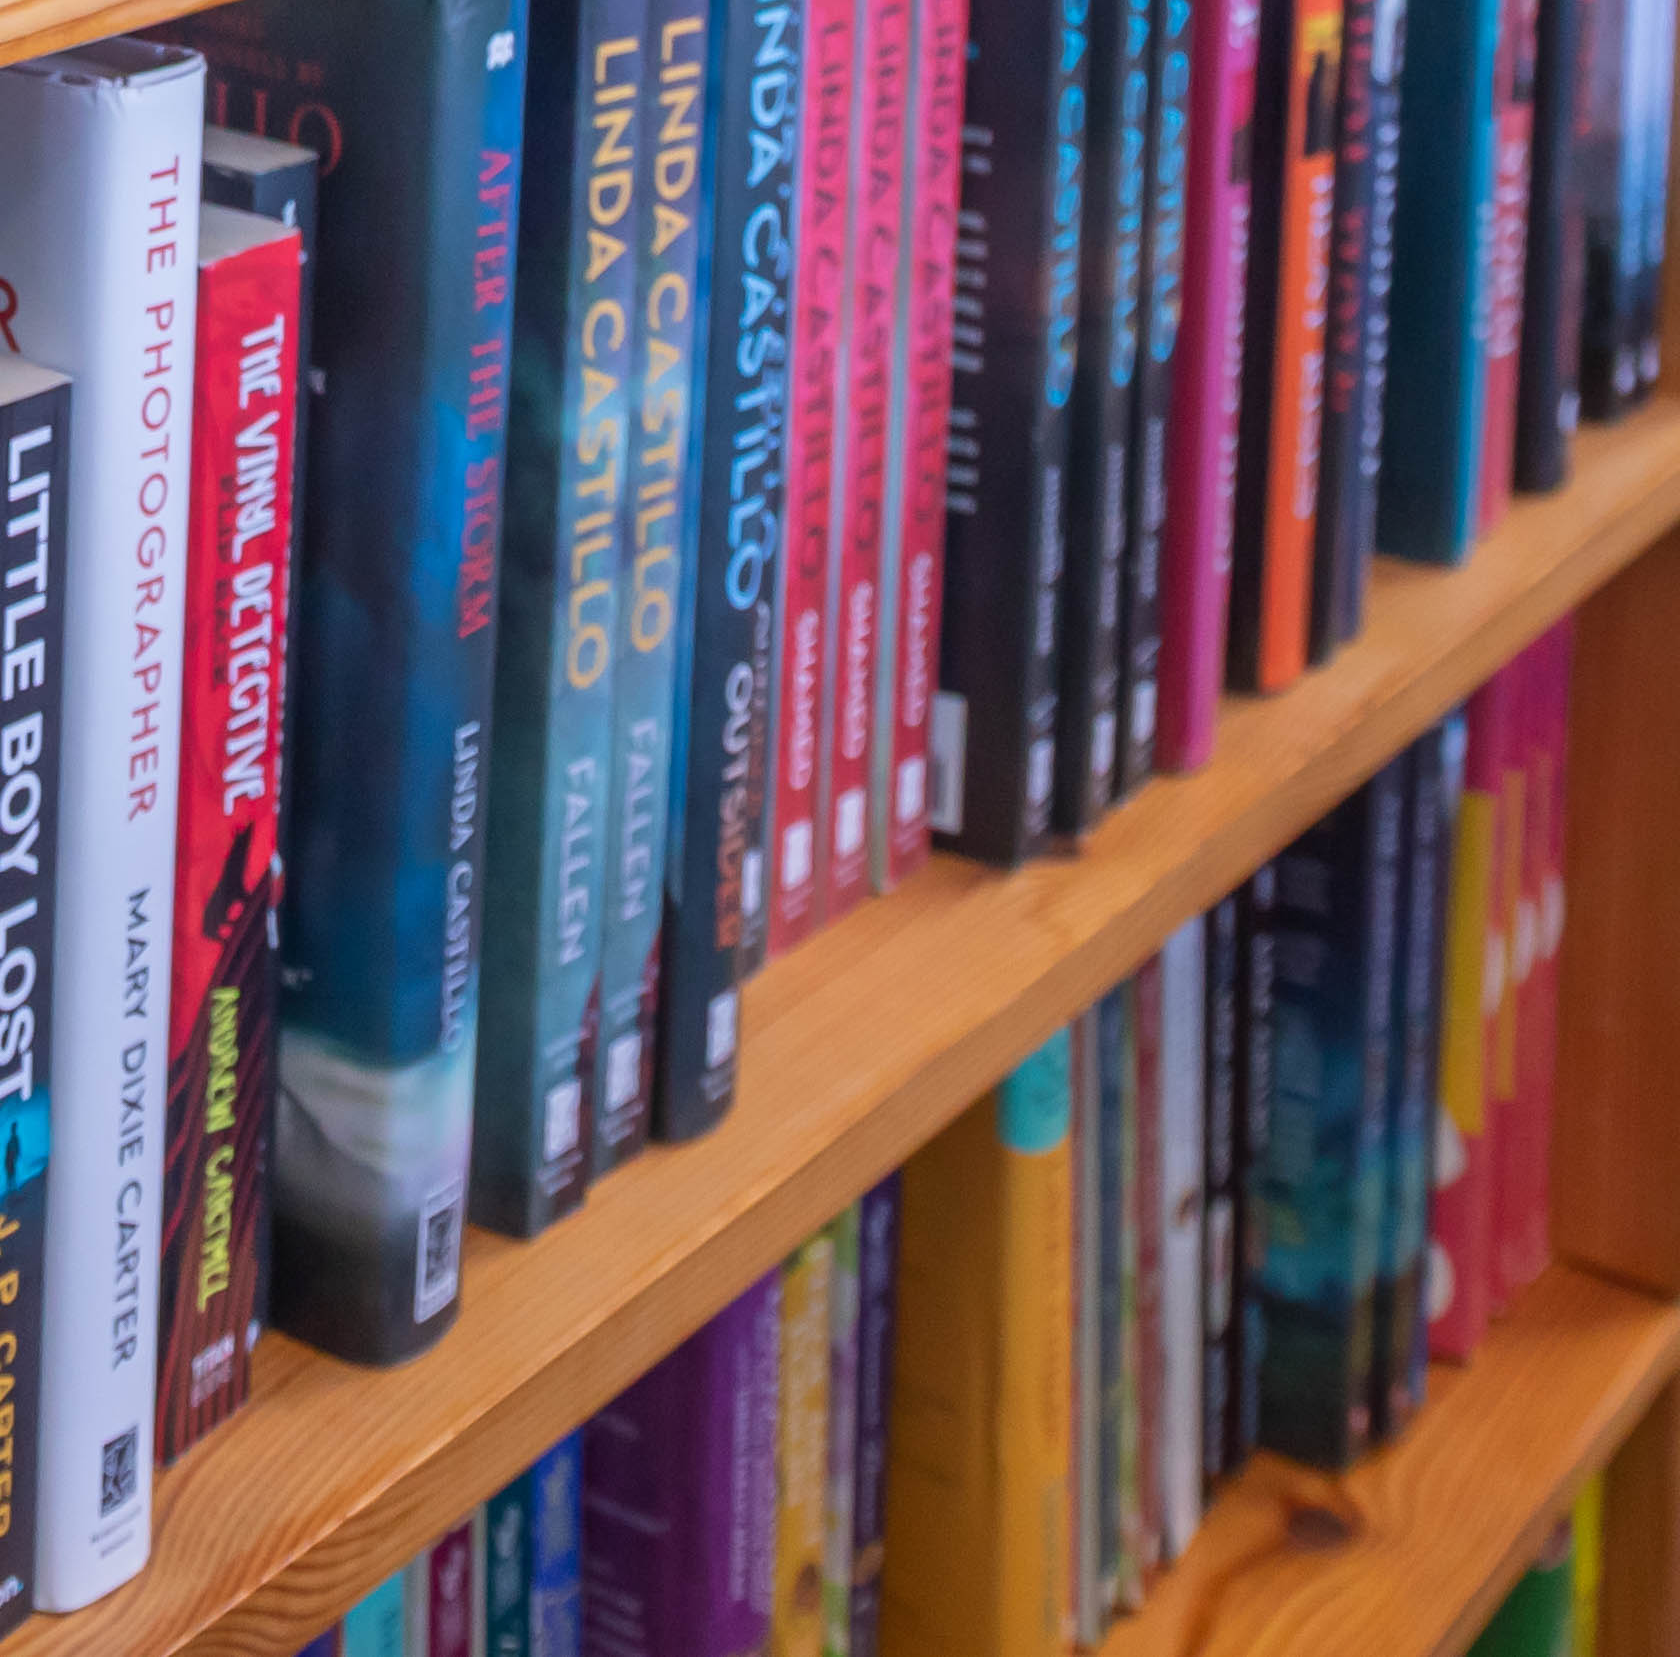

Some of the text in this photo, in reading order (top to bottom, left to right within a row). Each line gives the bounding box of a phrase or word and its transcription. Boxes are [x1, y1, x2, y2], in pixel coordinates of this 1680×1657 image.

[239, 314, 284, 408] THE
[457, 150, 512, 639] AFTER THE STORM
[725, 205, 782, 609] CASTILLO
[1046, 85, 1085, 408] CASTILLO
[0, 425, 53, 700] LITTLE
[129, 155, 179, 821] THE PHOTOGRAPHER
[232, 412, 280, 563] VINYL
[559, 38, 638, 966] LINDA CASTILLO FALLEN
[622, 18, 704, 921] LINDA CASTILLO FALLEN
[222, 563, 273, 816] DETECTIVE
[439, 721, 480, 1052] LINDA CASTILLO
[112, 889, 149, 1372] MARY DIXIE CARTER
